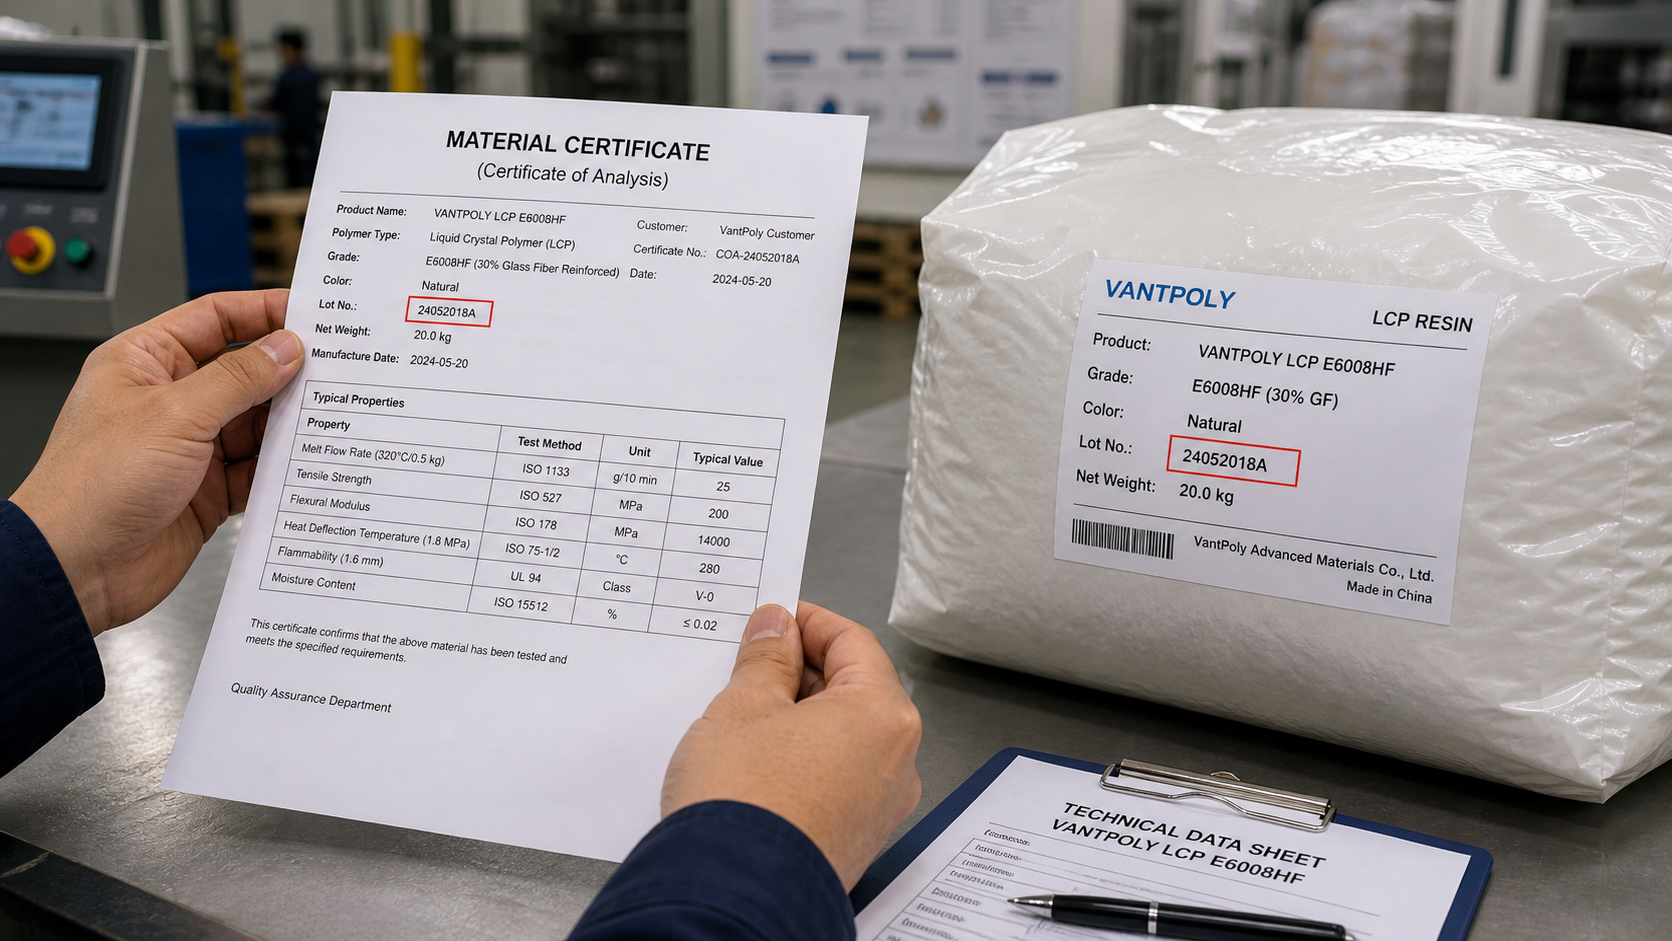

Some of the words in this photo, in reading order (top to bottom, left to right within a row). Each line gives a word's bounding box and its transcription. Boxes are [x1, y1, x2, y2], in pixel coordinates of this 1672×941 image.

[446, 130, 557, 152] MATERIAL
[565, 136, 710, 161] CERTIFICATE
[477, 162, 566, 181] (Certificate
[572, 167, 589, 182] of
[592, 168, 668, 191] Analysis)
[336, 204, 374, 215] Product
[376, 206, 407, 216] Name:
[434, 208, 492, 220] VANTPOLY
[494, 212, 516, 222] LCP
[519, 213, 567, 224] E6008HF
[637, 220, 688, 232] Customer:
[720, 225, 764, 240] VantPoly
[766, 228, 815, 240] Customer
[332, 227, 372, 240] Polymer
[374, 229, 400, 241] Type:
[430, 232, 460, 244] Liquid
[463, 234, 498, 246] Crystal
[501, 236, 543, 249] Polymer
[546, 239, 575, 252] (LCP)
[327, 251, 360, 262] Grade:
[633, 244, 683, 256] Certificate
[686, 247, 706, 257] No.:
[716, 249, 800, 264] COA-24052018A
[426, 256, 471, 268] E6008HF
[474, 259, 499, 270] (30%
[502, 260, 530, 272] Glass
[533, 262, 559, 273] Fiber
[561, 264, 620, 279] Reinforced)
[630, 268, 657, 279] Date:
[323, 275, 352, 286] Color:
[422, 280, 459, 292] Natural
[712, 274, 772, 287] 2024-05-20
[1106, 279, 1236, 309] VANTPOLY
[319, 299, 335, 309] Lot
[337, 300, 357, 311] No.:
[418, 305, 476, 318] 24052018A
[1373, 310, 1410, 327] LCP
[1415, 314, 1473, 333] RESIN
[315, 323, 332, 334] Net
[335, 325, 371, 338] Weight:
[414, 329, 437, 341] 20.0
[439, 331, 452, 344] kg
[1093, 332, 1151, 351] Product:
[311, 348, 371, 361] Manufacture
[373, 352, 399, 363] Date:
[410, 354, 468, 369] 2024-05-20
[1199, 344, 1283, 365] VANTPOLY
[1286, 353, 1319, 369] LCP
[1323, 357, 1396, 376] E6008HF
[1088, 366, 1133, 384] Grade:
[313, 391, 349, 404] Typical
[351, 394, 405, 408] Properties
[1192, 379, 1262, 399] E6008HF
[1266, 387, 1304, 404] (30%
[1310, 391, 1338, 411] GF)
[1083, 401, 1124, 418] Color:
[307, 417, 351, 432] Property
[1187, 414, 1242, 433] Natural
[518, 436, 540, 447] Test
[542, 438, 582, 451] Method
[1079, 435, 1101, 450] Lot
[1105, 438, 1132, 454] No.:
[301, 443, 322, 454] Melt
[324, 445, 347, 456] Flow
[349, 447, 372, 458] Rate
[375, 449, 427, 464] (320°C/0.5
[429, 454, 445, 467] kg)
[629, 446, 651, 457] Unit
[693, 452, 731, 465] Typical
[734, 455, 763, 467] Value
[1182, 449, 1267, 472] 24052018A
[297, 468, 329, 481] Tensile
[331, 472, 372, 487] Strength
[522, 463, 542, 475] ISO
[546, 466, 570, 477] 1133
[613, 472, 636, 484] g/10
[639, 475, 657, 485] min
[1076, 469, 1099, 484] Net
[1103, 472, 1155, 493] Weight:
[716, 481, 730, 492] 25
[520, 490, 540, 501] ISO
[542, 492, 562, 503] 527
[1179, 483, 1211, 500] 20.0
[1216, 488, 1234, 507] kg
[290, 494, 328, 507] Flexural
[330, 498, 370, 512] Modulus
[619, 499, 643, 511] MPa
[708, 508, 729, 520] 200
[515, 517, 535, 528] ISO
[539, 519, 557, 530] 178
[283, 520, 307, 532] Heat
[309, 523, 356, 536] Deflection
[360, 528, 420, 544] Temperature
[423, 535, 442, 546] (1.8
[444, 537, 470, 550] MPa)
[614, 526, 638, 539] MPa
[699, 535, 730, 548] 14000
[278, 546, 338, 564] Flammability
[340, 553, 359, 565] (1.6
[361, 557, 384, 568] mm)
[505, 543, 525, 554] ISO
[528, 545, 560, 558] 75-1/2
[616, 554, 628, 565] °C
[1194, 535, 1247, 556] VantPoly
[1250, 544, 1312, 564] Advanced
[1316, 554, 1374, 573] Materials
[1379, 563, 1404, 580] Co.,
[1409, 568, 1434, 582] Ltd.
[699, 563, 720, 574] 280
[271, 572, 314, 586] Moisture
[317, 577, 356, 591] Content
[511, 571, 525, 582] UL
[528, 572, 541, 583] 94
[603, 581, 631, 593] Class
[1347, 580, 1379, 595] Made
[1382, 586, 1393, 597] in
[1397, 588, 1432, 604] China
[696, 590, 714, 602] V-0
[494, 597, 514, 608] ISO
[518, 599, 548, 612] 15512
[607, 608, 617, 620] %
[693, 619, 717, 631] 0.02
[251, 618, 270, 630] This
[272, 623, 317, 635] certificate
[319, 628, 359, 640] confirms
[362, 632, 380, 643] that
[382, 634, 397, 645] the
[399, 636, 428, 648] above
[430, 642, 469, 653] material
[470, 644, 488, 655] has
[490, 646, 515, 658] been
[517, 651, 547, 662] tested
[548, 655, 568, 664] and
[245, 636, 275, 646] meets
[277, 638, 293, 648] the
[295, 642, 339, 654] specified
[341, 647, 406, 662] requirements.
[231, 682, 268, 699] Quality
[270, 688, 326, 704] Assurance
[329, 695, 392, 713] Department
[1064, 802, 1179, 838] TECHNICAL
[1185, 829, 1241, 852] DATA
[1248, 844, 1326, 868] SHEET
[1053, 819, 1160, 851] VANTPOLY
[1162, 844, 1206, 861] LCP
[1210, 855, 1305, 884] E6008HF
